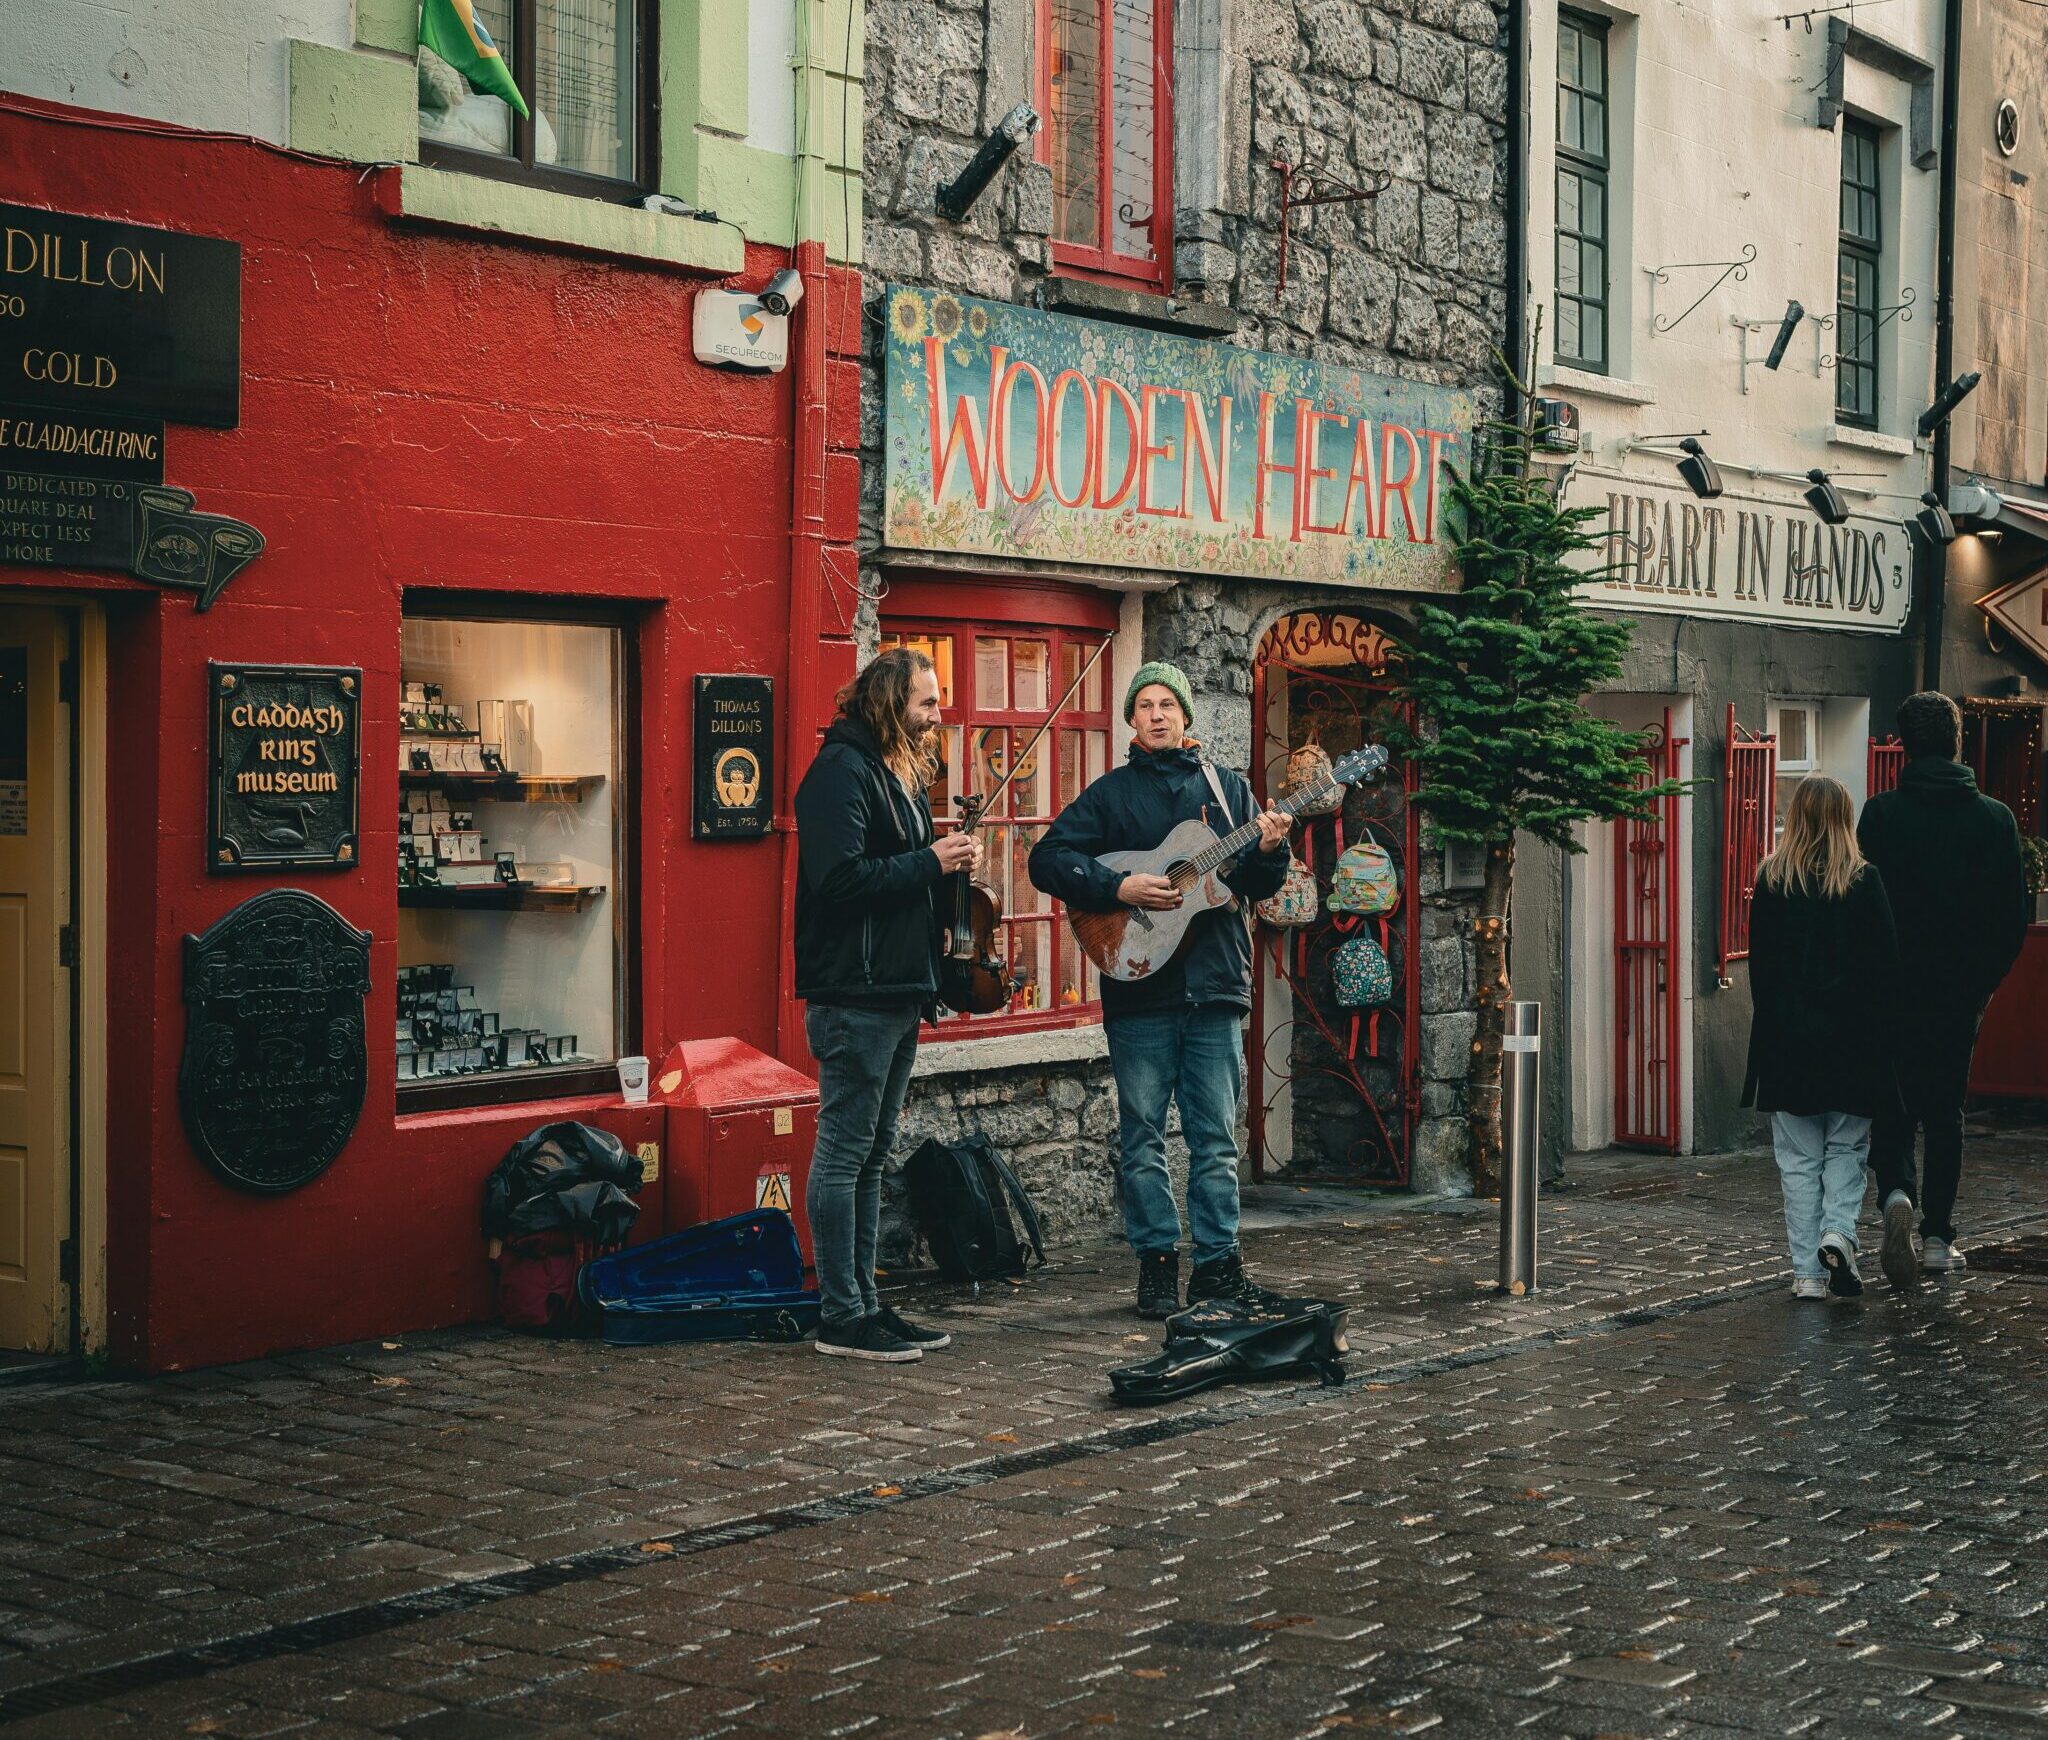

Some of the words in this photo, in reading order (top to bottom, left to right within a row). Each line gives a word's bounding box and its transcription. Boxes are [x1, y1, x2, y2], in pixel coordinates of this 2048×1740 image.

[6, 229, 164, 294] DILLON
[715, 344, 782, 362] SECURECOM
[23, 348, 117, 389] GOLD
[14, 421, 115, 457] CLADDAGH
[116, 432, 158, 460] RING
[922, 335, 1231, 523] WOODEN
[1252, 391, 1456, 546] HEART
[7, 475, 97, 497] DEDICATED
[56, 503, 97, 520] DEAL
[57, 525, 93, 542] LESS
[6, 544, 54, 562] MORE
[1597, 491, 1726, 598] HEART
[1734, 510, 1774, 602] IN
[1783, 516, 1886, 616] HANDS
[713, 700, 760, 713] THOMAS
